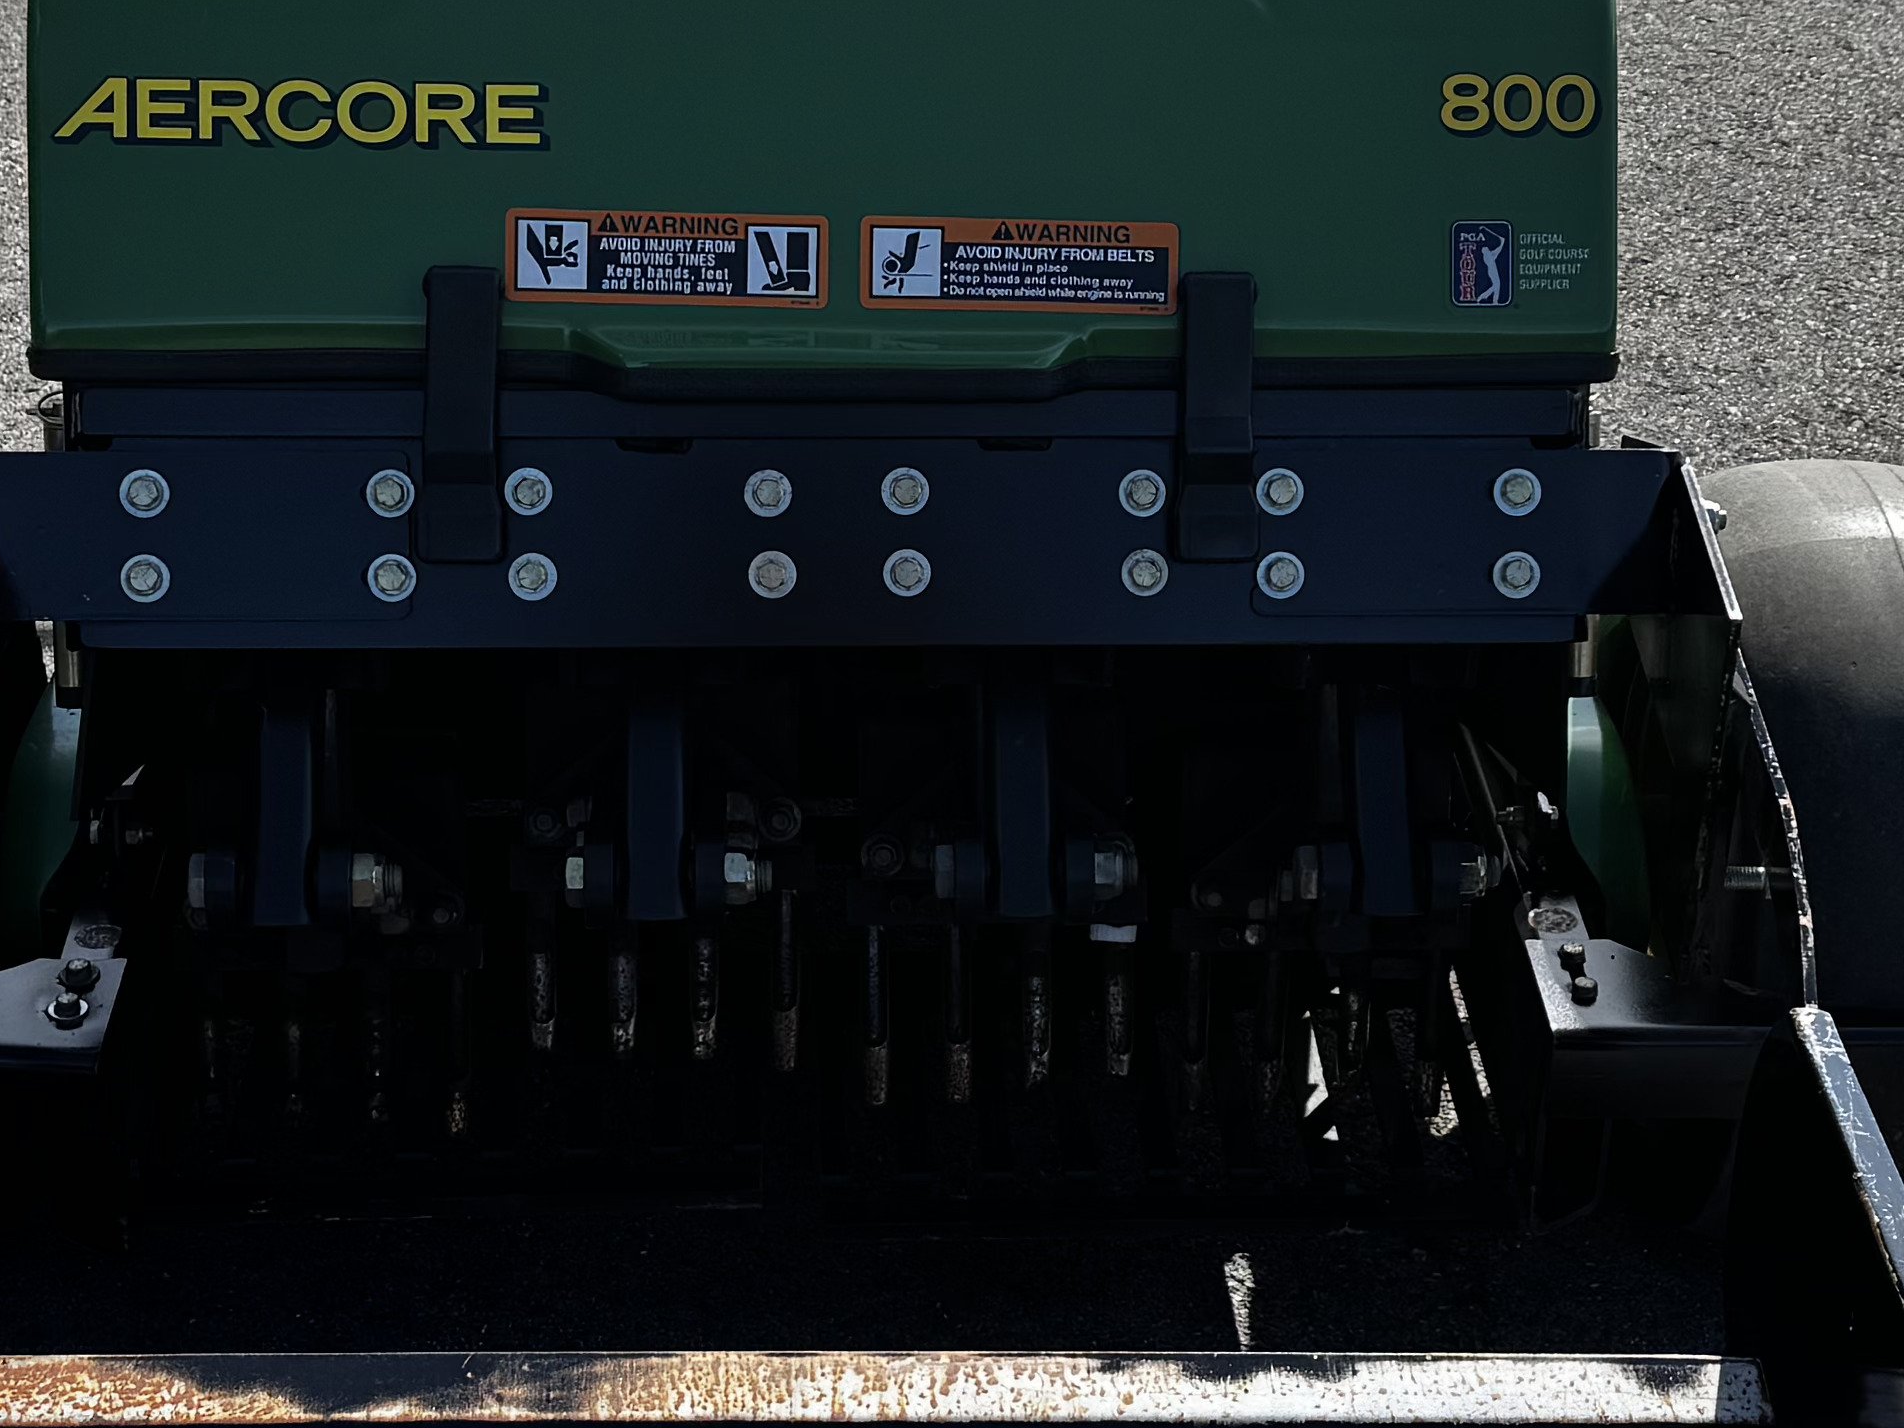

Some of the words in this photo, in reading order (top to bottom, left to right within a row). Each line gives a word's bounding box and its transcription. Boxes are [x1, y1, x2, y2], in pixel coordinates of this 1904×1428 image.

[53, 76, 542, 144] AERCORE
[1440, 73, 1596, 132] 800
[622, 216, 739, 235] WARNING
[1016, 224, 1130, 244] WARNING
[1459, 233, 1485, 241] PGA
[599, 238, 641, 251] AVOID
[644, 239, 694, 252] INJURY
[697, 240, 736, 253] FROM
[620, 253, 673, 266] MOVING
[676, 254, 716, 267] TINES
[955, 246, 1000, 259] AVOID
[1005, 247, 1058, 261] INJURY
[1061, 248, 1105, 261] FROM
[1108, 249, 1155, 263] BELTS
[606, 265, 642, 280] Keep
[648, 266, 695, 281] hands,
[701, 267, 729, 281] feet
[950, 261, 979, 273] Keep
[983, 261, 1019, 272] shield
[1022, 262, 1033, 272] in
[1036, 263, 1068, 274] place
[601, 278, 627, 291] and
[633, 278, 690, 294] clothing
[697, 281, 733, 295] away
[950, 273, 983, 285] Keep
[987, 274, 1020, 285] hands
[1024, 275, 1047, 285] and
[1050, 275, 1099, 288] clothing
[1103, 277, 1133, 289] away
[949, 285, 964, 296] Do
[967, 286, 984, 297] not
